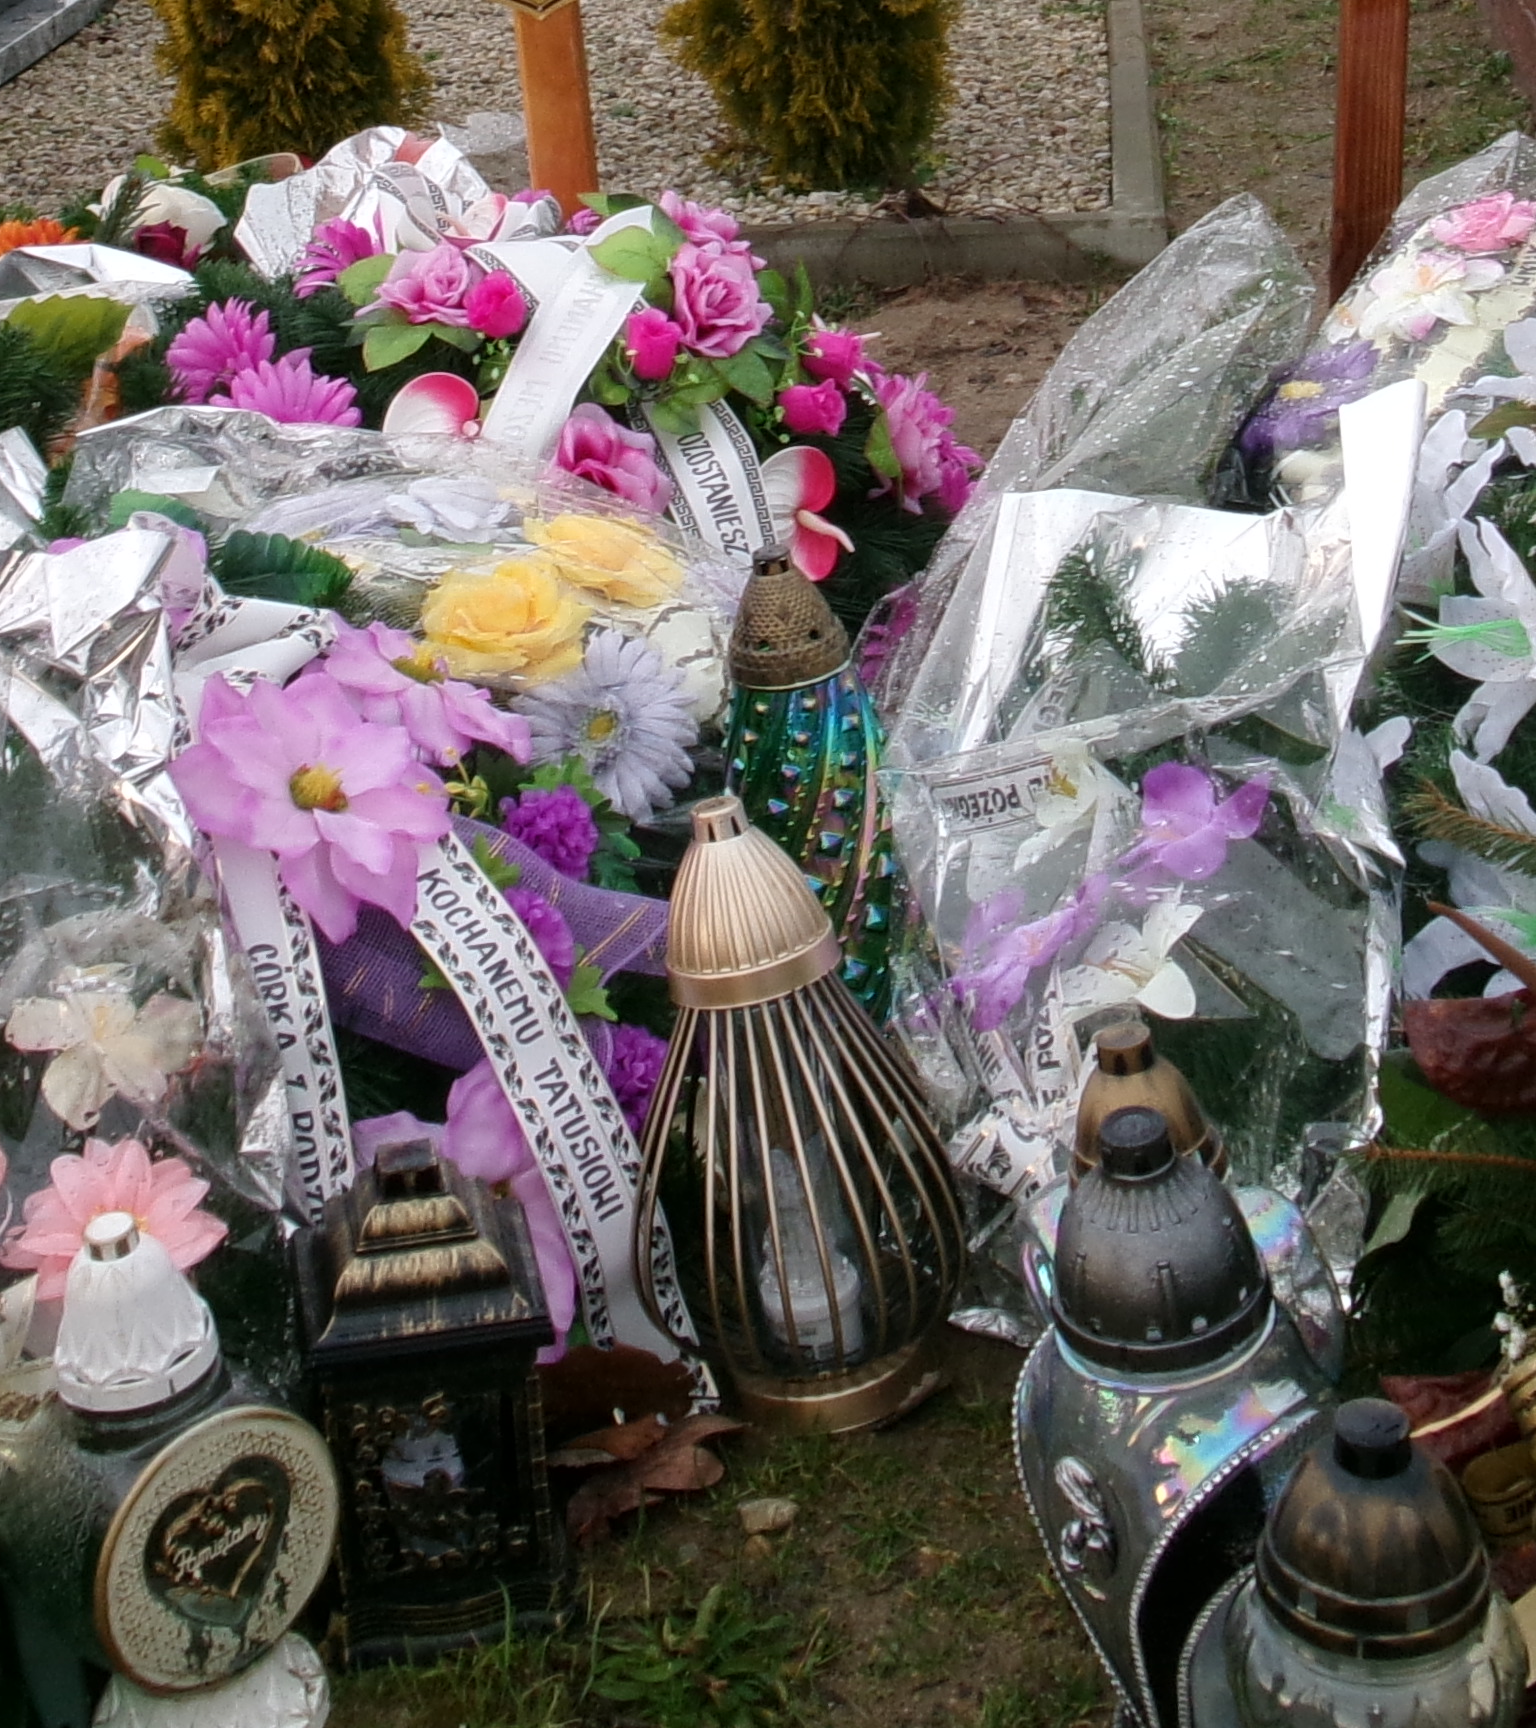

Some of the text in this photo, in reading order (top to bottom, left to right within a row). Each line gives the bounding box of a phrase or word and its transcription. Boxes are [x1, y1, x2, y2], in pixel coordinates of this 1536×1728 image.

[677, 429, 753, 558] OZOSTANIESZ
[247, 942, 298, 1054] CÓRKA
[417, 866, 625, 1224] KOCHANEMU TATUSIOWI
